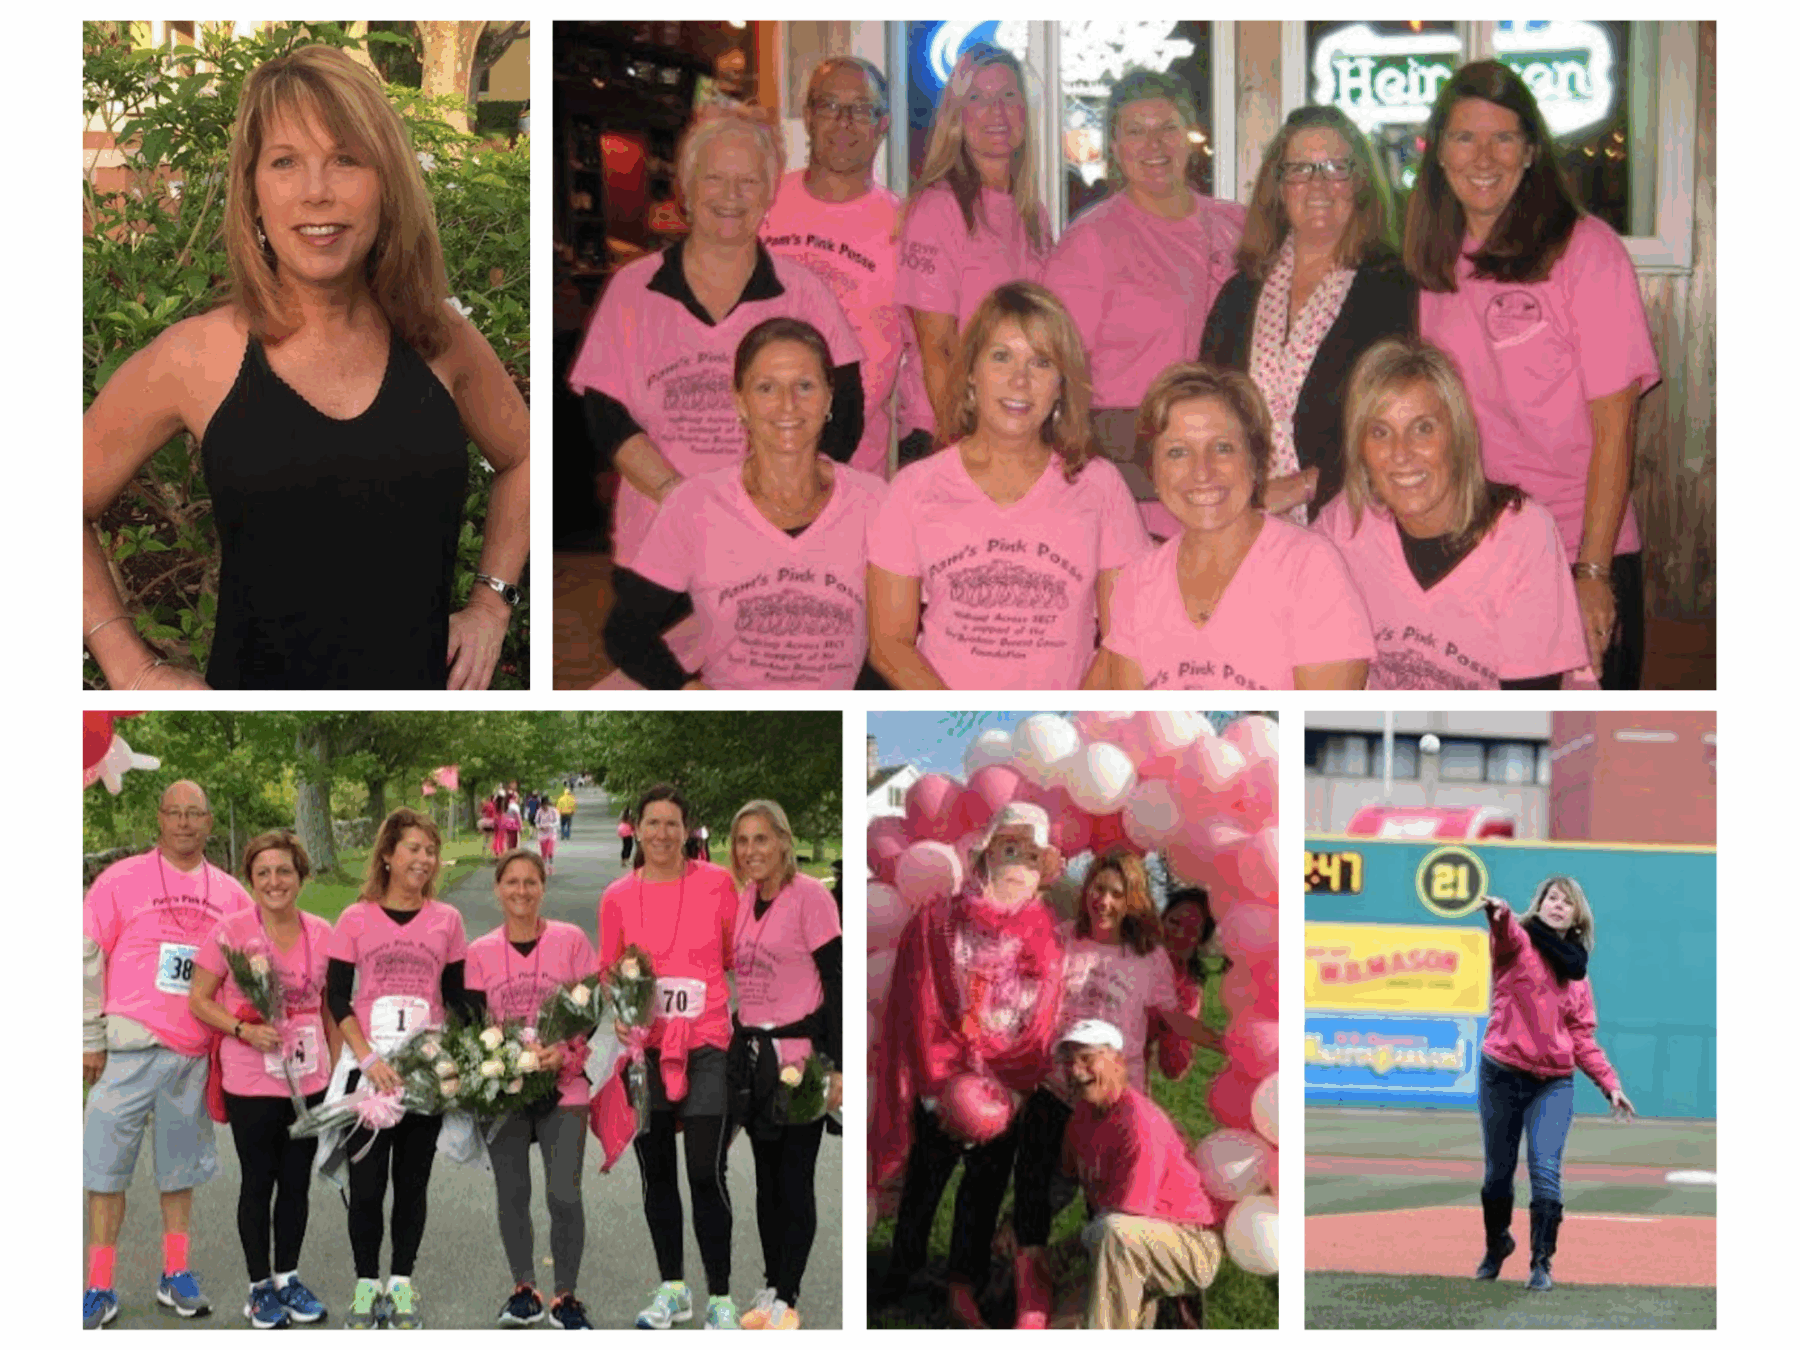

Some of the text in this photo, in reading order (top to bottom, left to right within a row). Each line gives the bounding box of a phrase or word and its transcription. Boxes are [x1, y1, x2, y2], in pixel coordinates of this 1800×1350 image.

[929, 538, 1083, 582] Pam's Pink Posse
[777, 567, 815, 583] Pink
[1402, 626, 1436, 648] Pink
[1177, 660, 1215, 678] Pink
[1433, 863, 1470, 900] 21
[663, 990, 688, 1013] 70
[397, 1008, 406, 1032] 1
